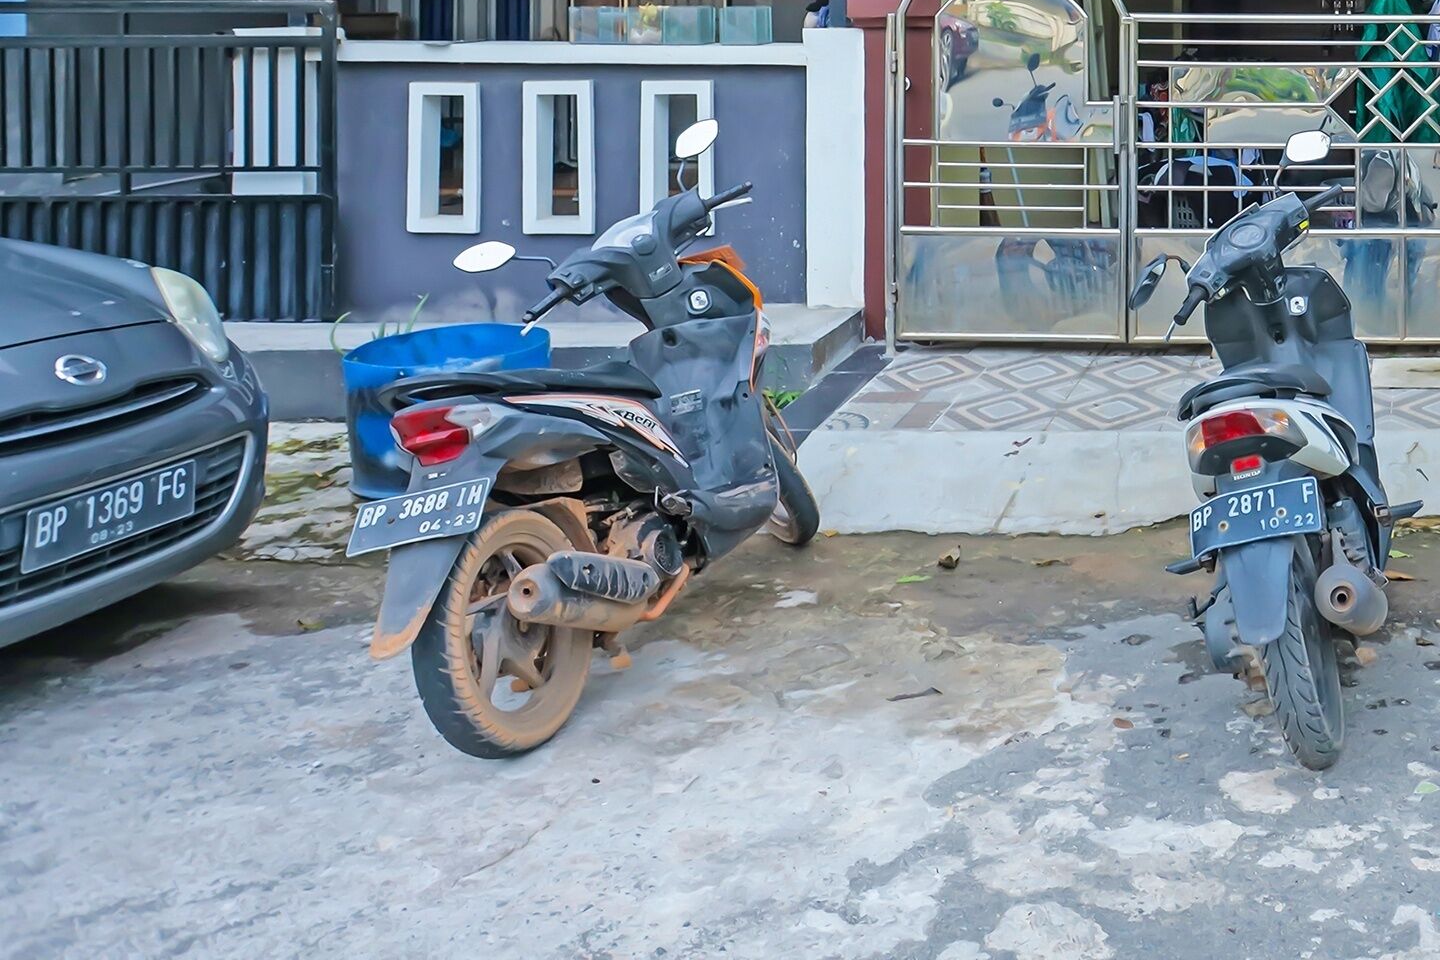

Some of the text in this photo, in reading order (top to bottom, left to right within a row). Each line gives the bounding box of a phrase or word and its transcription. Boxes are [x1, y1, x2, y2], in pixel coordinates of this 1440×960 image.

[35, 467, 187, 549] BP 1369 FG
[358, 504, 388, 529] BP
[398, 490, 450, 520] 3688
[1192, 482, 1315, 533] BP 2871 F
